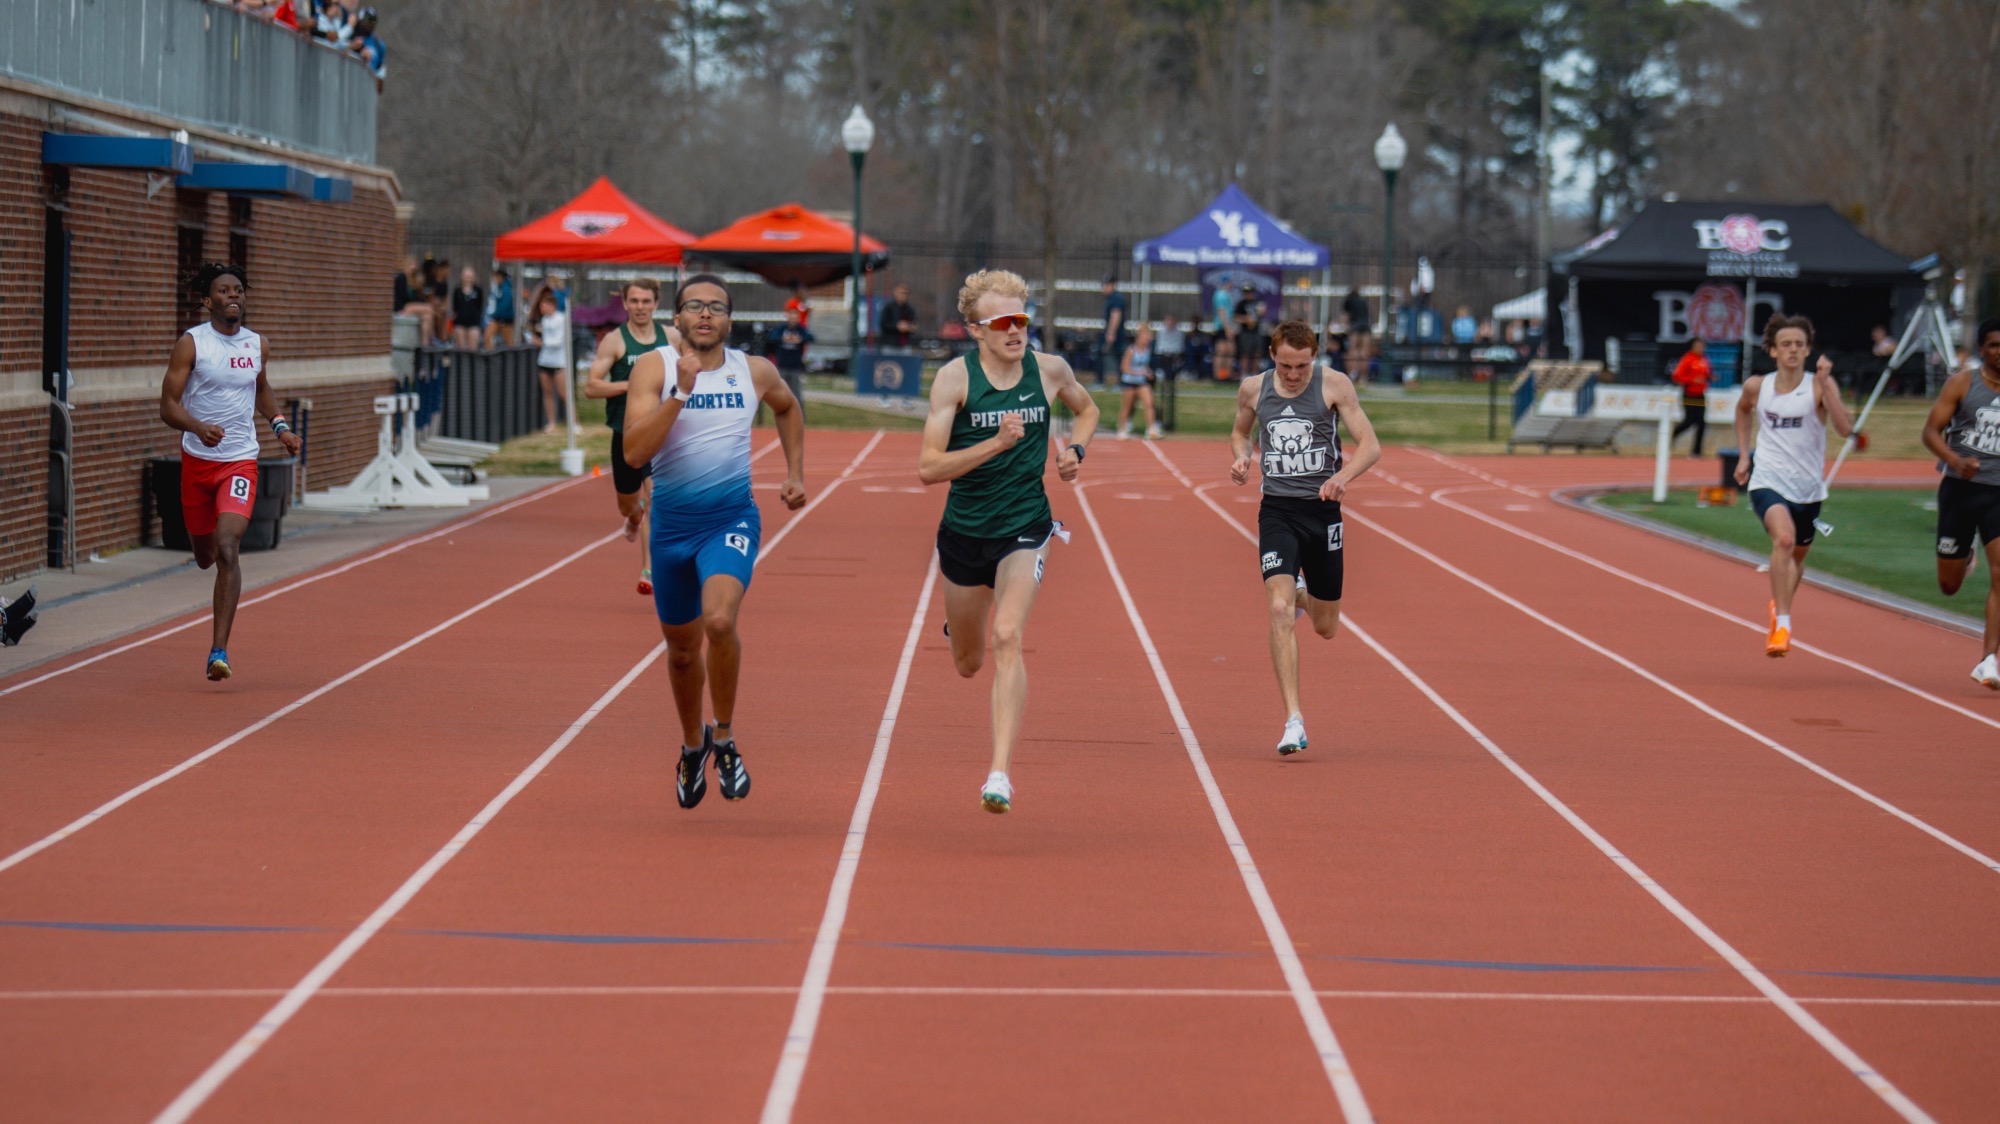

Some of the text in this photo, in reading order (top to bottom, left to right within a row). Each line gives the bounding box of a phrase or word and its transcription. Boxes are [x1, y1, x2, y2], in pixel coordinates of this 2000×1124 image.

[230, 357, 254, 369] EGA
[681, 392, 745, 409] HORTER
[1770, 416, 1803, 429] LEE
[1265, 450, 1326, 475] TMU
[234, 478, 248, 497] 8
[730, 535, 746, 550] 6
[1330, 525, 1342, 547] 4
[1262, 559, 1282, 572] TMU
